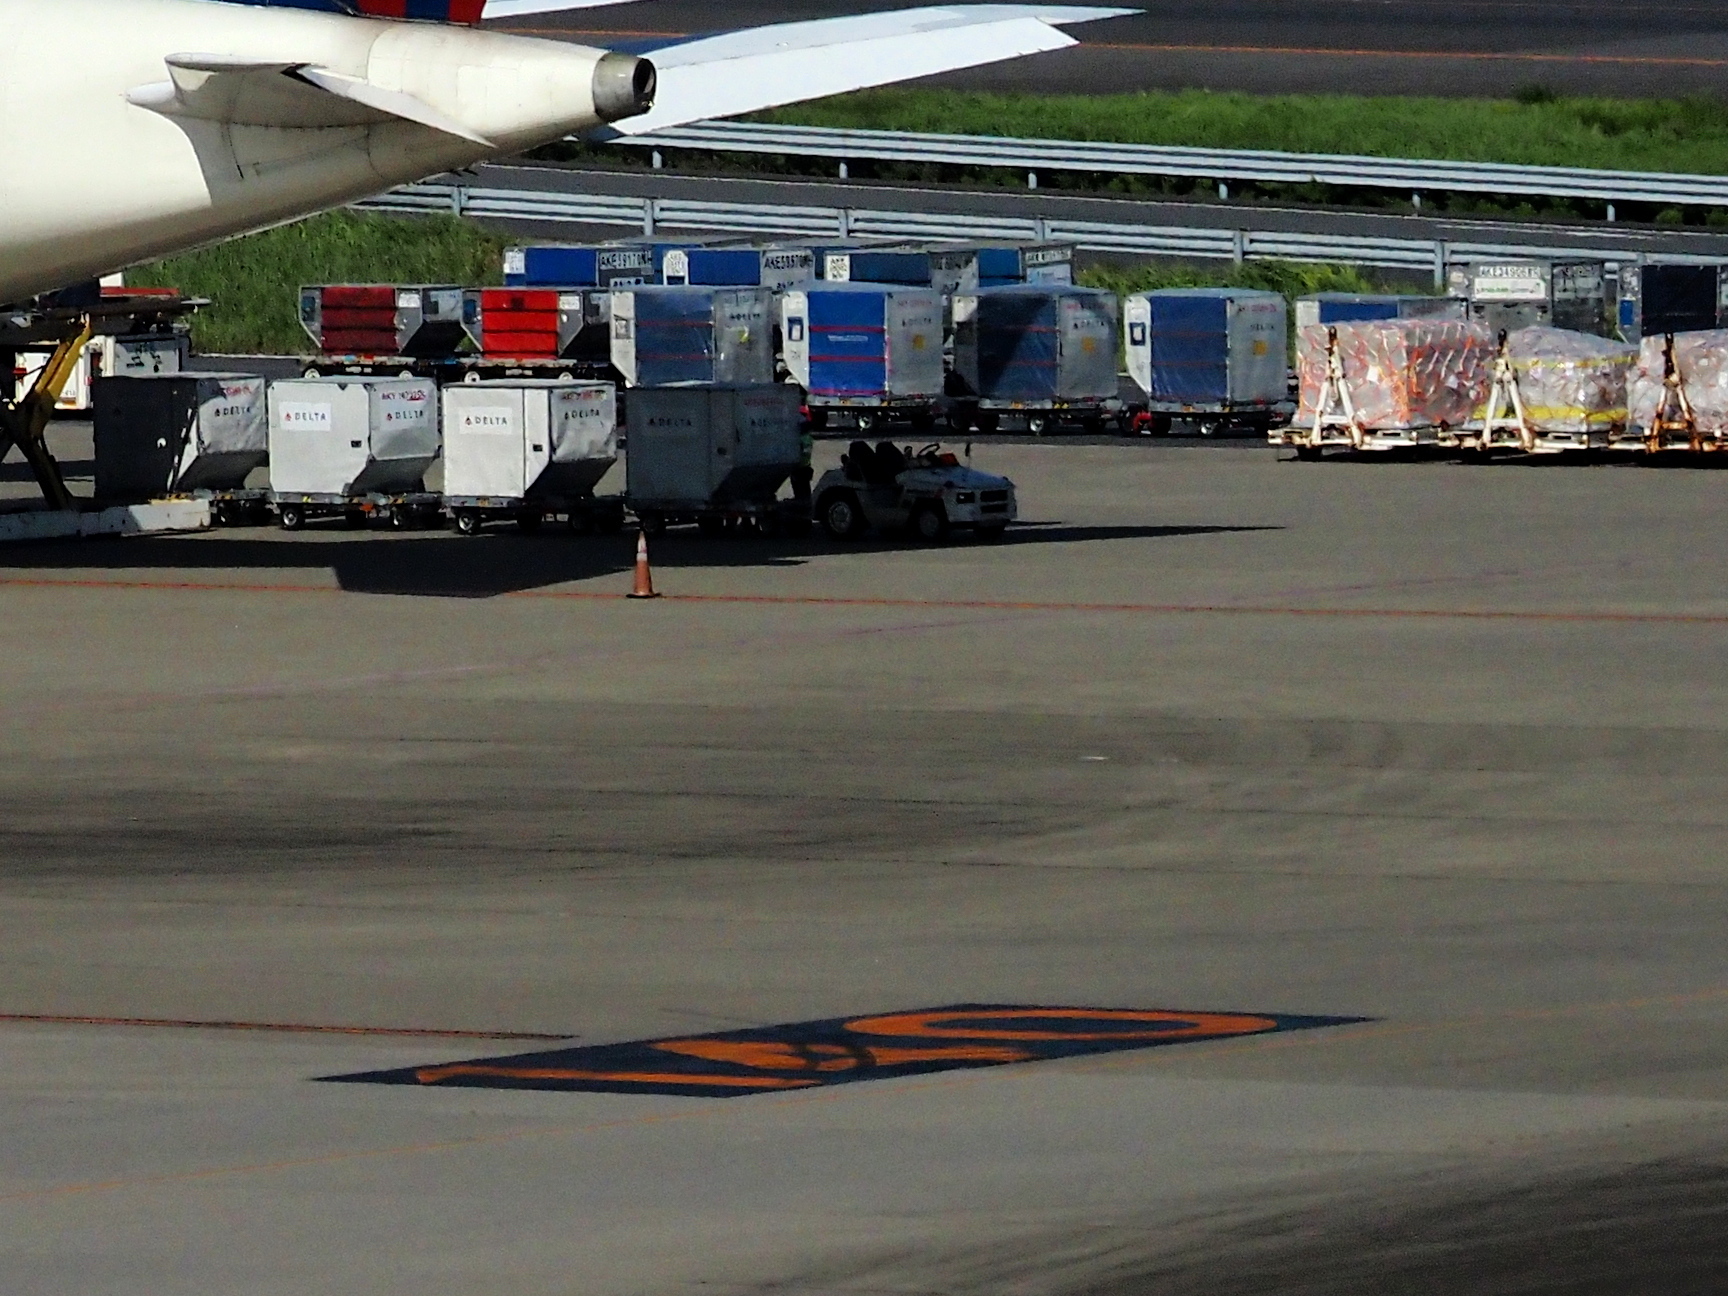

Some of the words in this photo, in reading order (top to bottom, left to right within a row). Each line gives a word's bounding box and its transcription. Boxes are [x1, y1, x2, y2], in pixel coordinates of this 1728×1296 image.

[223, 406, 251, 416] DELTA
[294, 411, 327, 421] DELTA
[394, 410, 424, 420] DELTA
[570, 409, 600, 420] DELTA
[474, 416, 508, 426] DELTA
